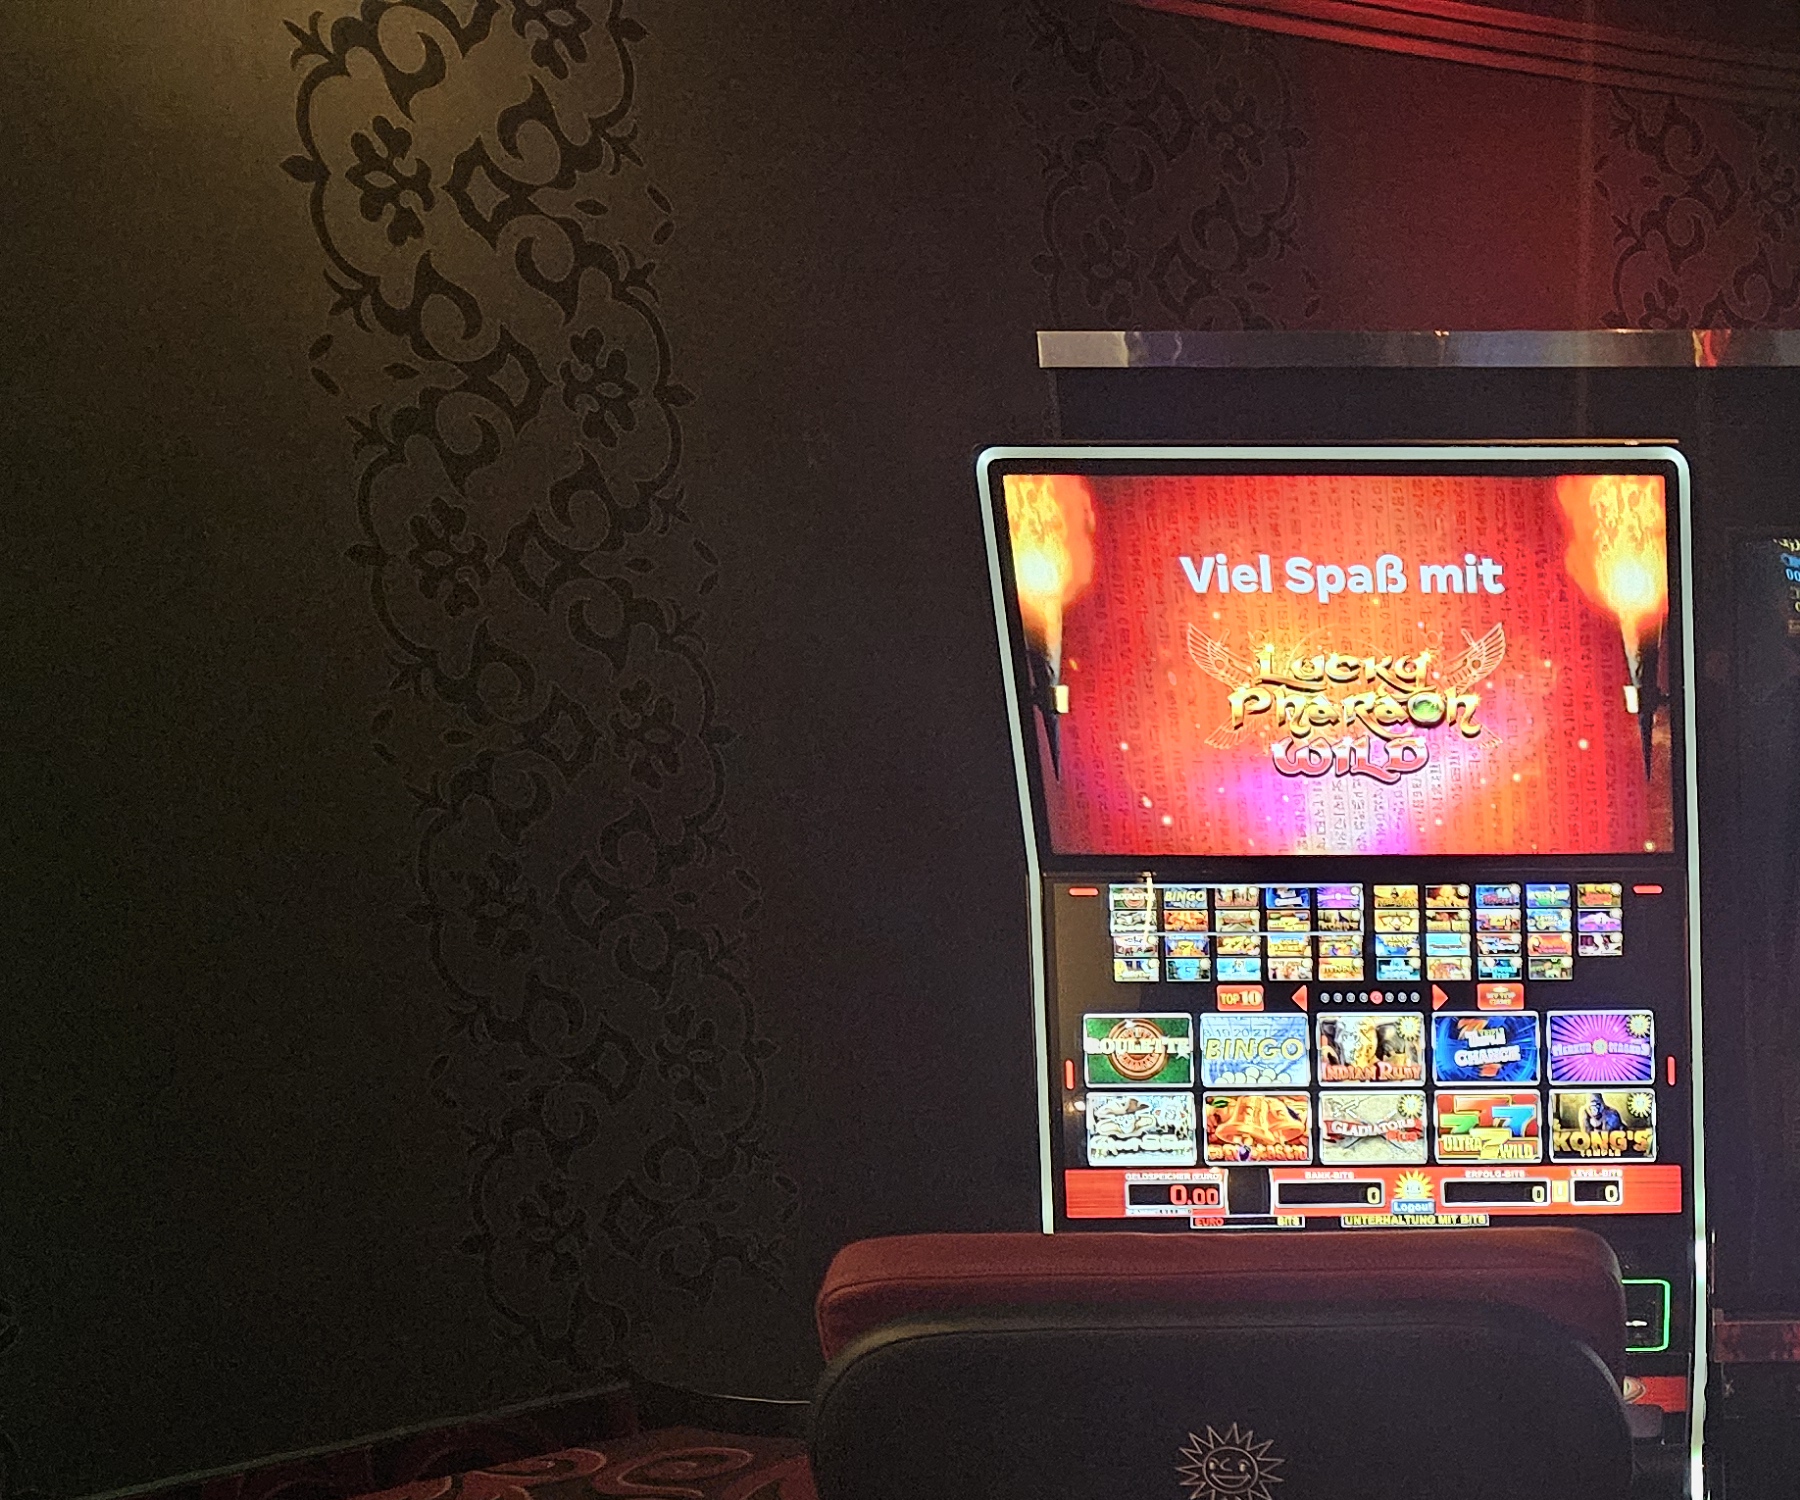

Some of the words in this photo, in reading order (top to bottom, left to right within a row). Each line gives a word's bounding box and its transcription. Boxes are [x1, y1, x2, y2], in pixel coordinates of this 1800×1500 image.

[1179, 554, 1274, 594] Viel
[1285, 554, 1408, 604] Spaß
[1420, 554, 1506, 594] mit
[1165, 890, 1204, 902] BINGO
[1220, 993, 1240, 1005] TOP
[1240, 990, 1263, 1006] 10
[1205, 1037, 1305, 1061] BINGO
[1442, 1134, 1483, 1152] ULTRA
[1553, 1129, 1653, 1152] KONG'S
[1169, 1184, 1219, 1206] 0.00
[1366, 1186, 1381, 1204] 0
[1393, 1201, 1434, 1214] Logout
[1195, 1217, 1224, 1227] EURO
[1344, 1215, 1436, 1226] UNTERHALTUNG
